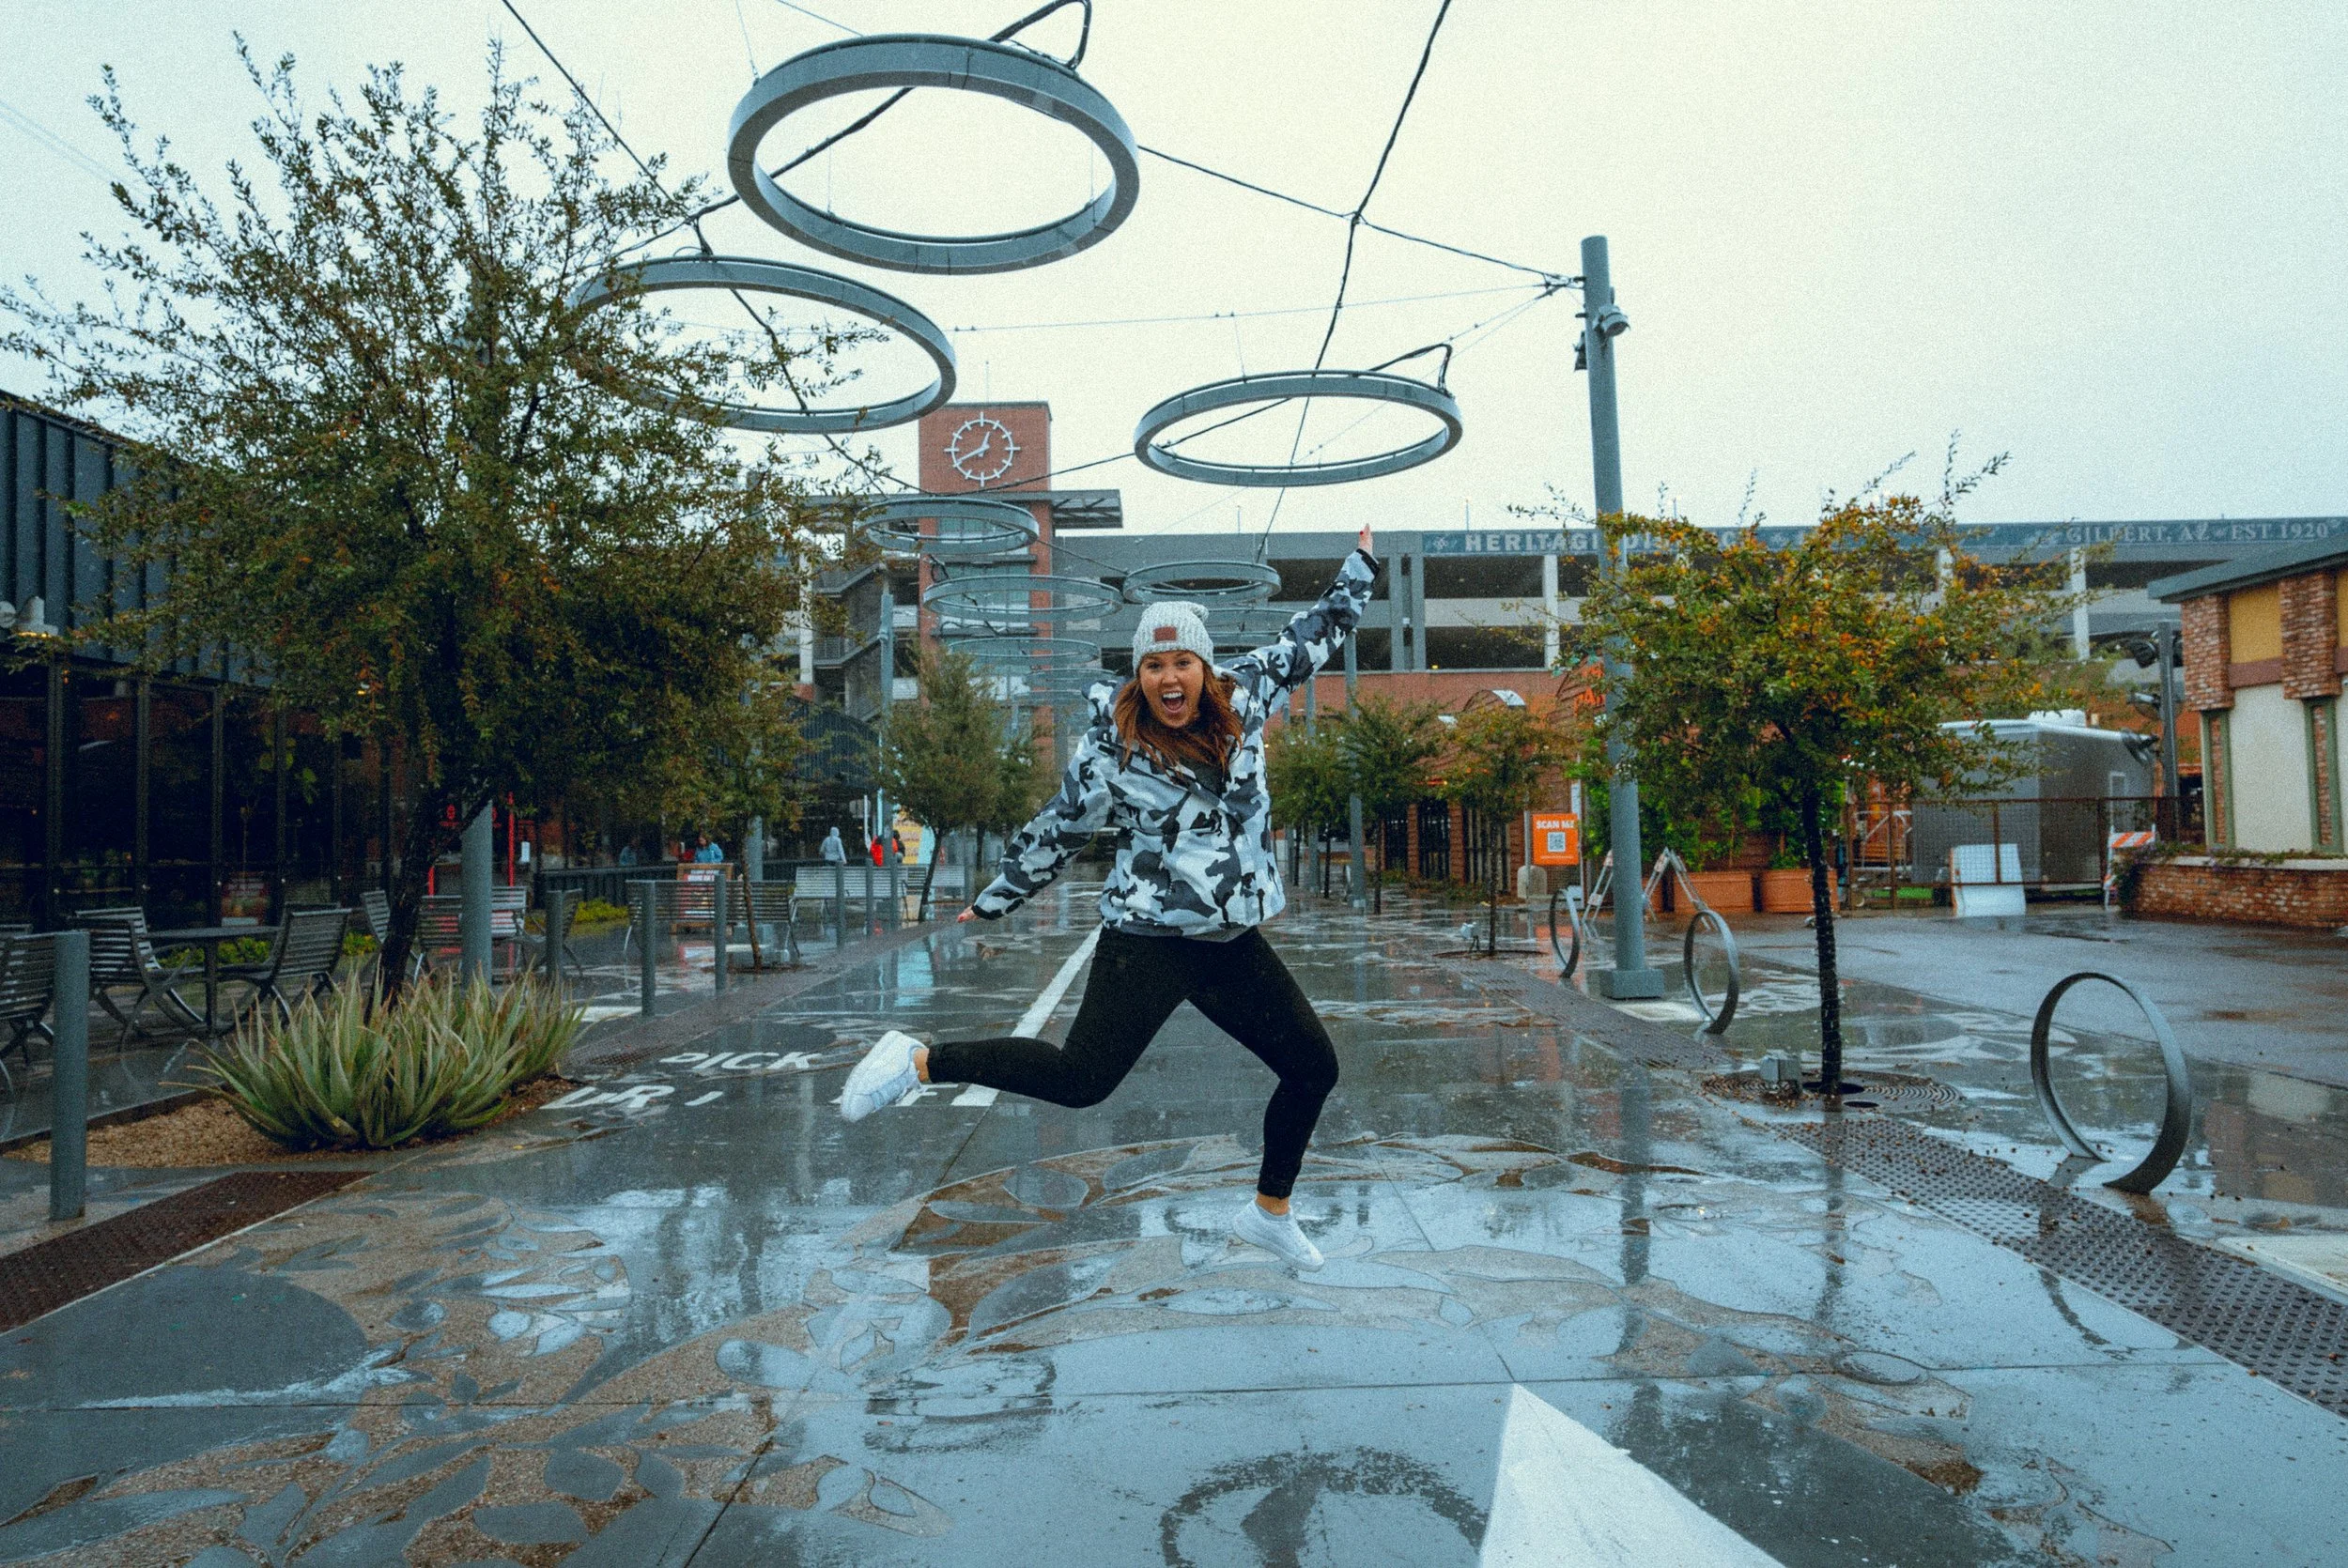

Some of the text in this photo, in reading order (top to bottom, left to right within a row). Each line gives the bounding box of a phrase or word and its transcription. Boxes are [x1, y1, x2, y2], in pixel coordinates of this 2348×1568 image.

[2281, 522, 2328, 539] 1920
[1536, 820, 1574, 829] SCAN ME
